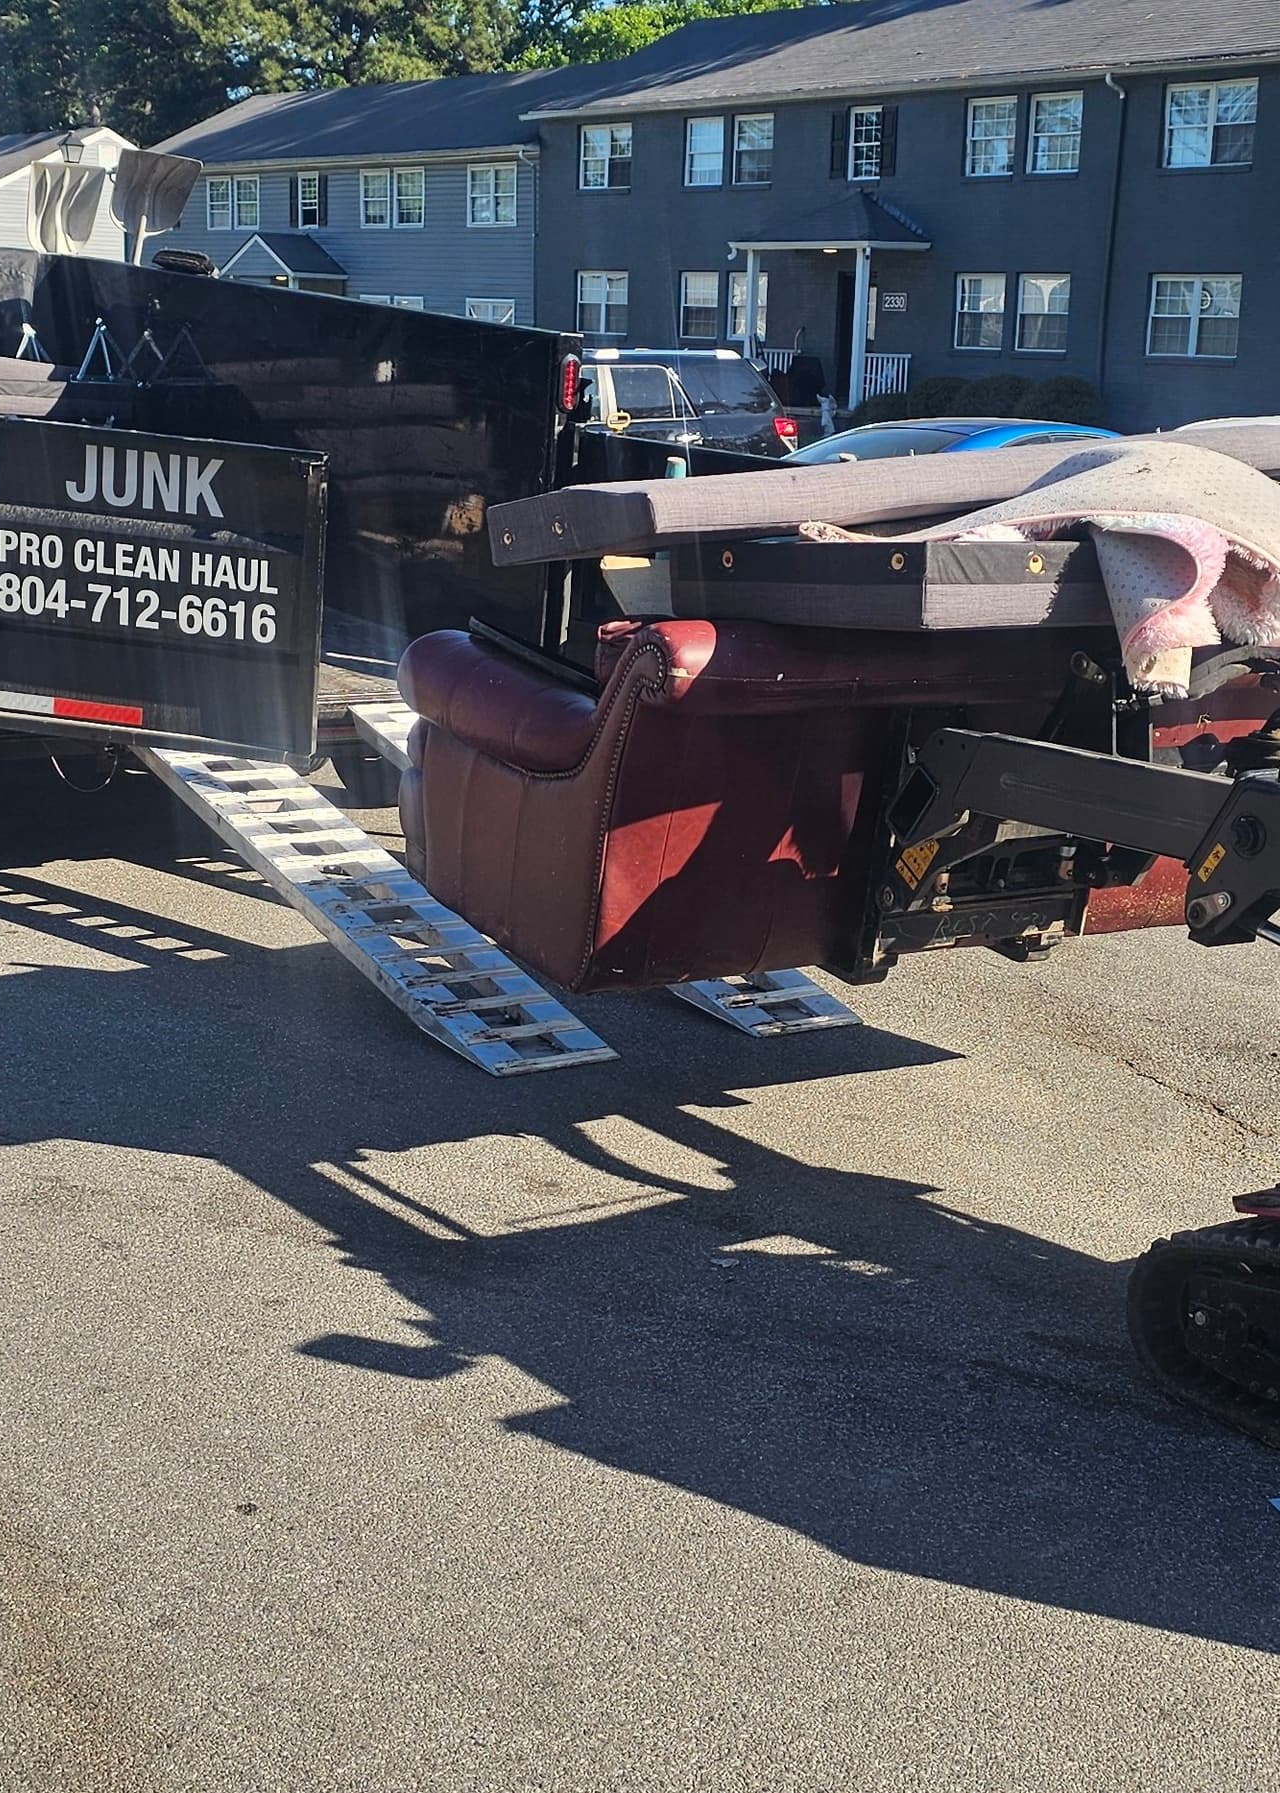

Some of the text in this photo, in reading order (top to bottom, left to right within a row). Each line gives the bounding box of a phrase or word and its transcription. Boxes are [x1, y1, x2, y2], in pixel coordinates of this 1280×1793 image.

[884, 296, 905, 308] 2330
[65, 444, 224, 518] JUNK
[73, 538, 180, 583] CLEAN
[191, 551, 279, 595] HAUL
